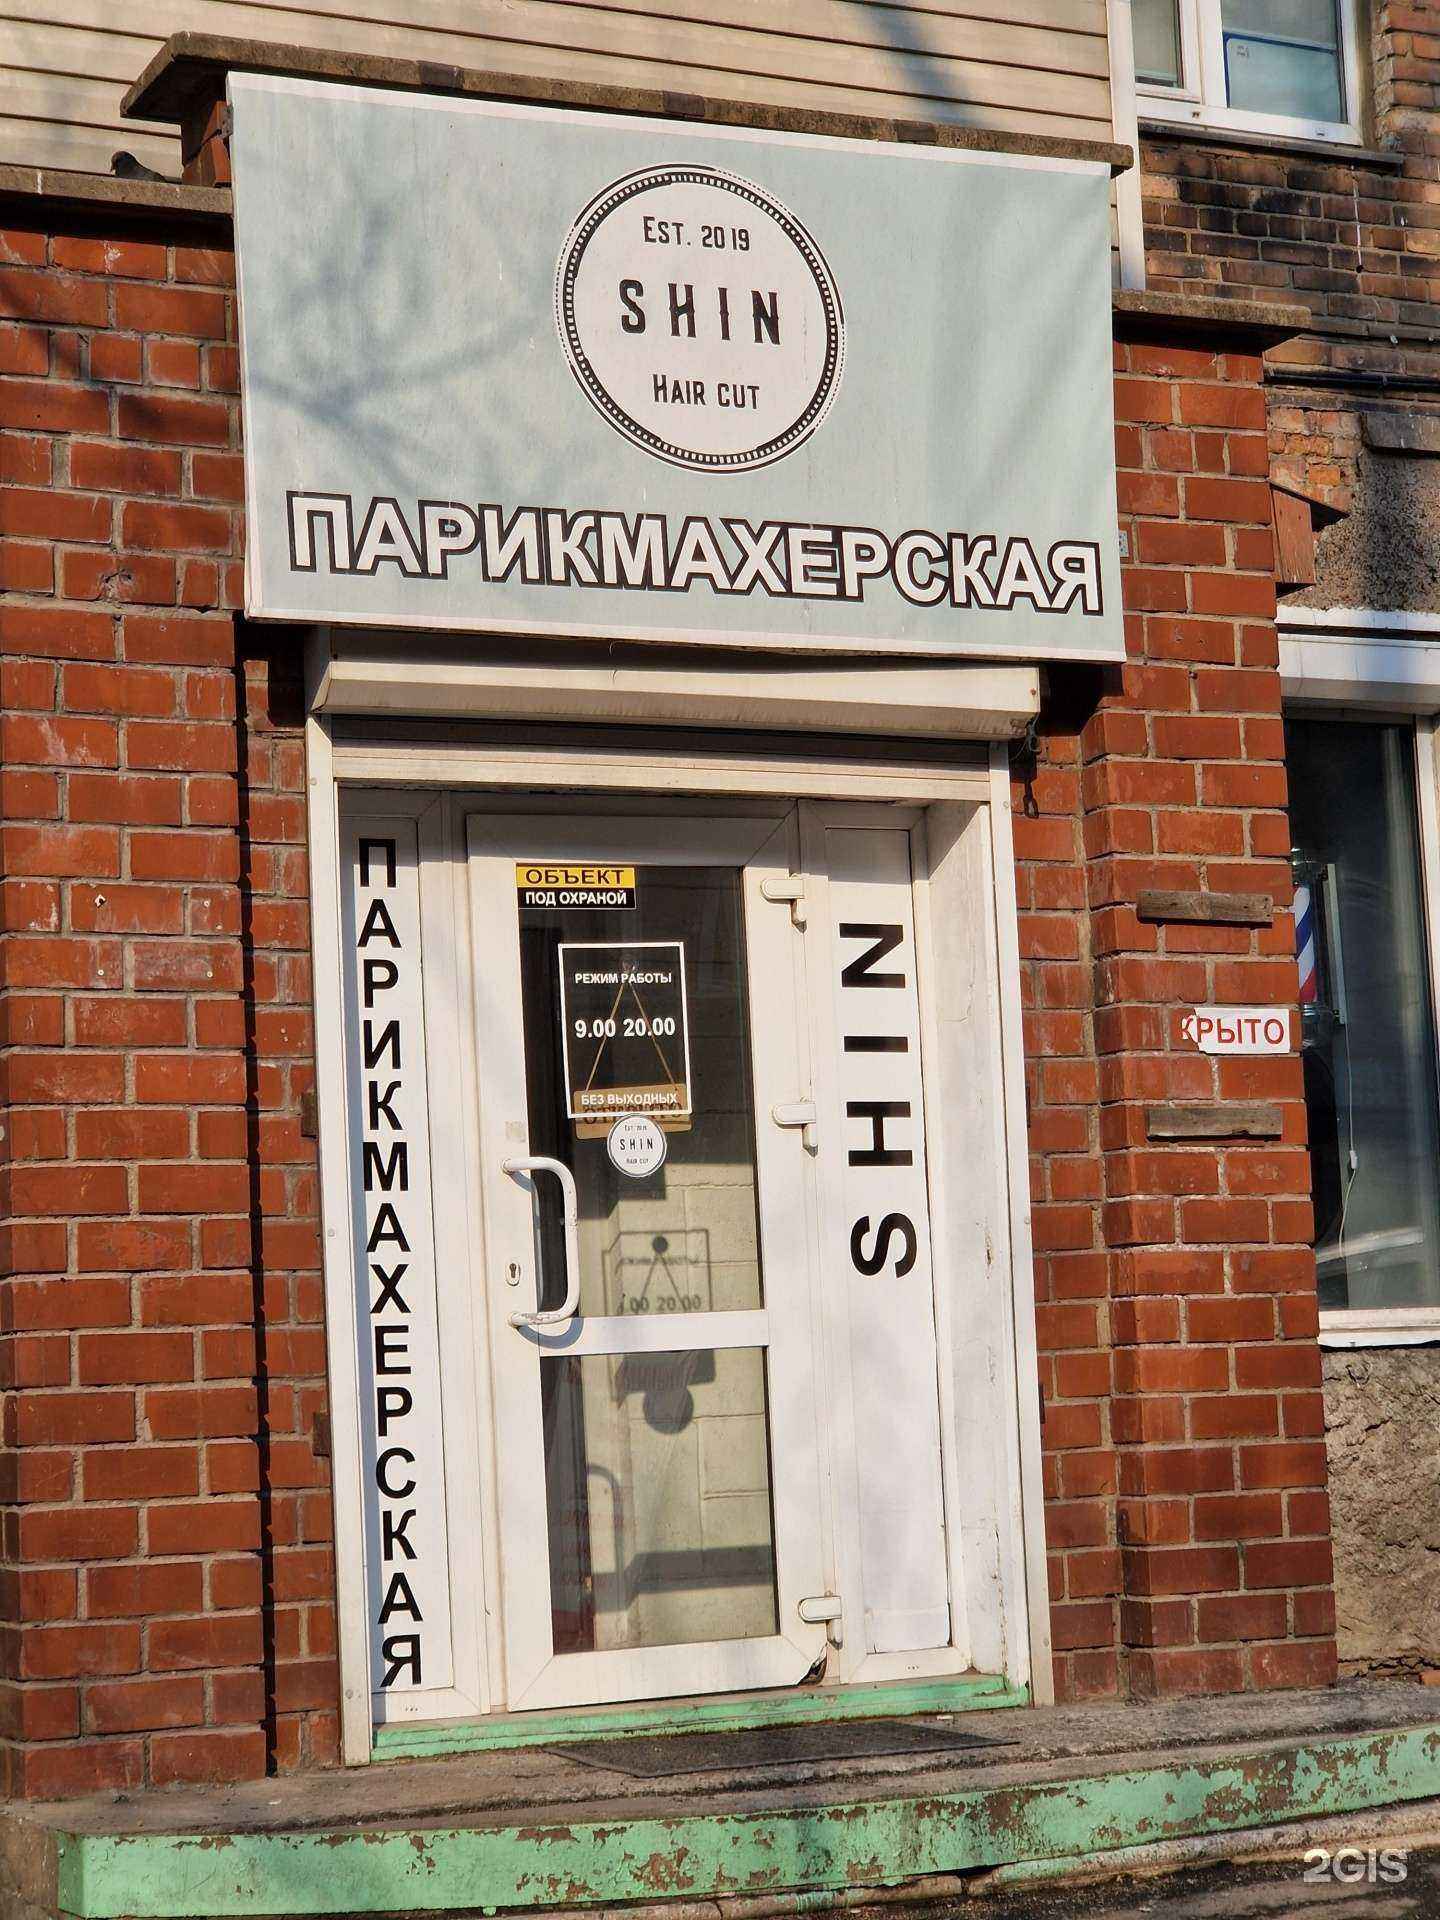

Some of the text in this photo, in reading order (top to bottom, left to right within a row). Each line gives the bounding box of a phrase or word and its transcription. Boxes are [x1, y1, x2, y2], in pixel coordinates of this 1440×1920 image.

[701, 224, 750, 251] 2019
[618, 279, 781, 345] SHIN
[717, 382, 760, 410] CUT
[285, 489, 1104, 617] ПАРИКМАХЕРСКАЯ
[525, 868, 625, 885] ОБЪЕКТ
[525, 889, 627, 907] ПОД ОХРАНОЙ
[574, 972, 673, 984] РЕЖИМ РАБОТЫ
[574, 1016, 676, 1039] 9.00 20.00
[581, 1092, 678, 1107] БЕЗ ВЫХОДНЫХ
[838, 922, 918, 1279] SHIN
[619, 1138, 654, 1151] SHIN
[356, 837, 424, 1689] ПАРИКМАХЕРСКАЯ
